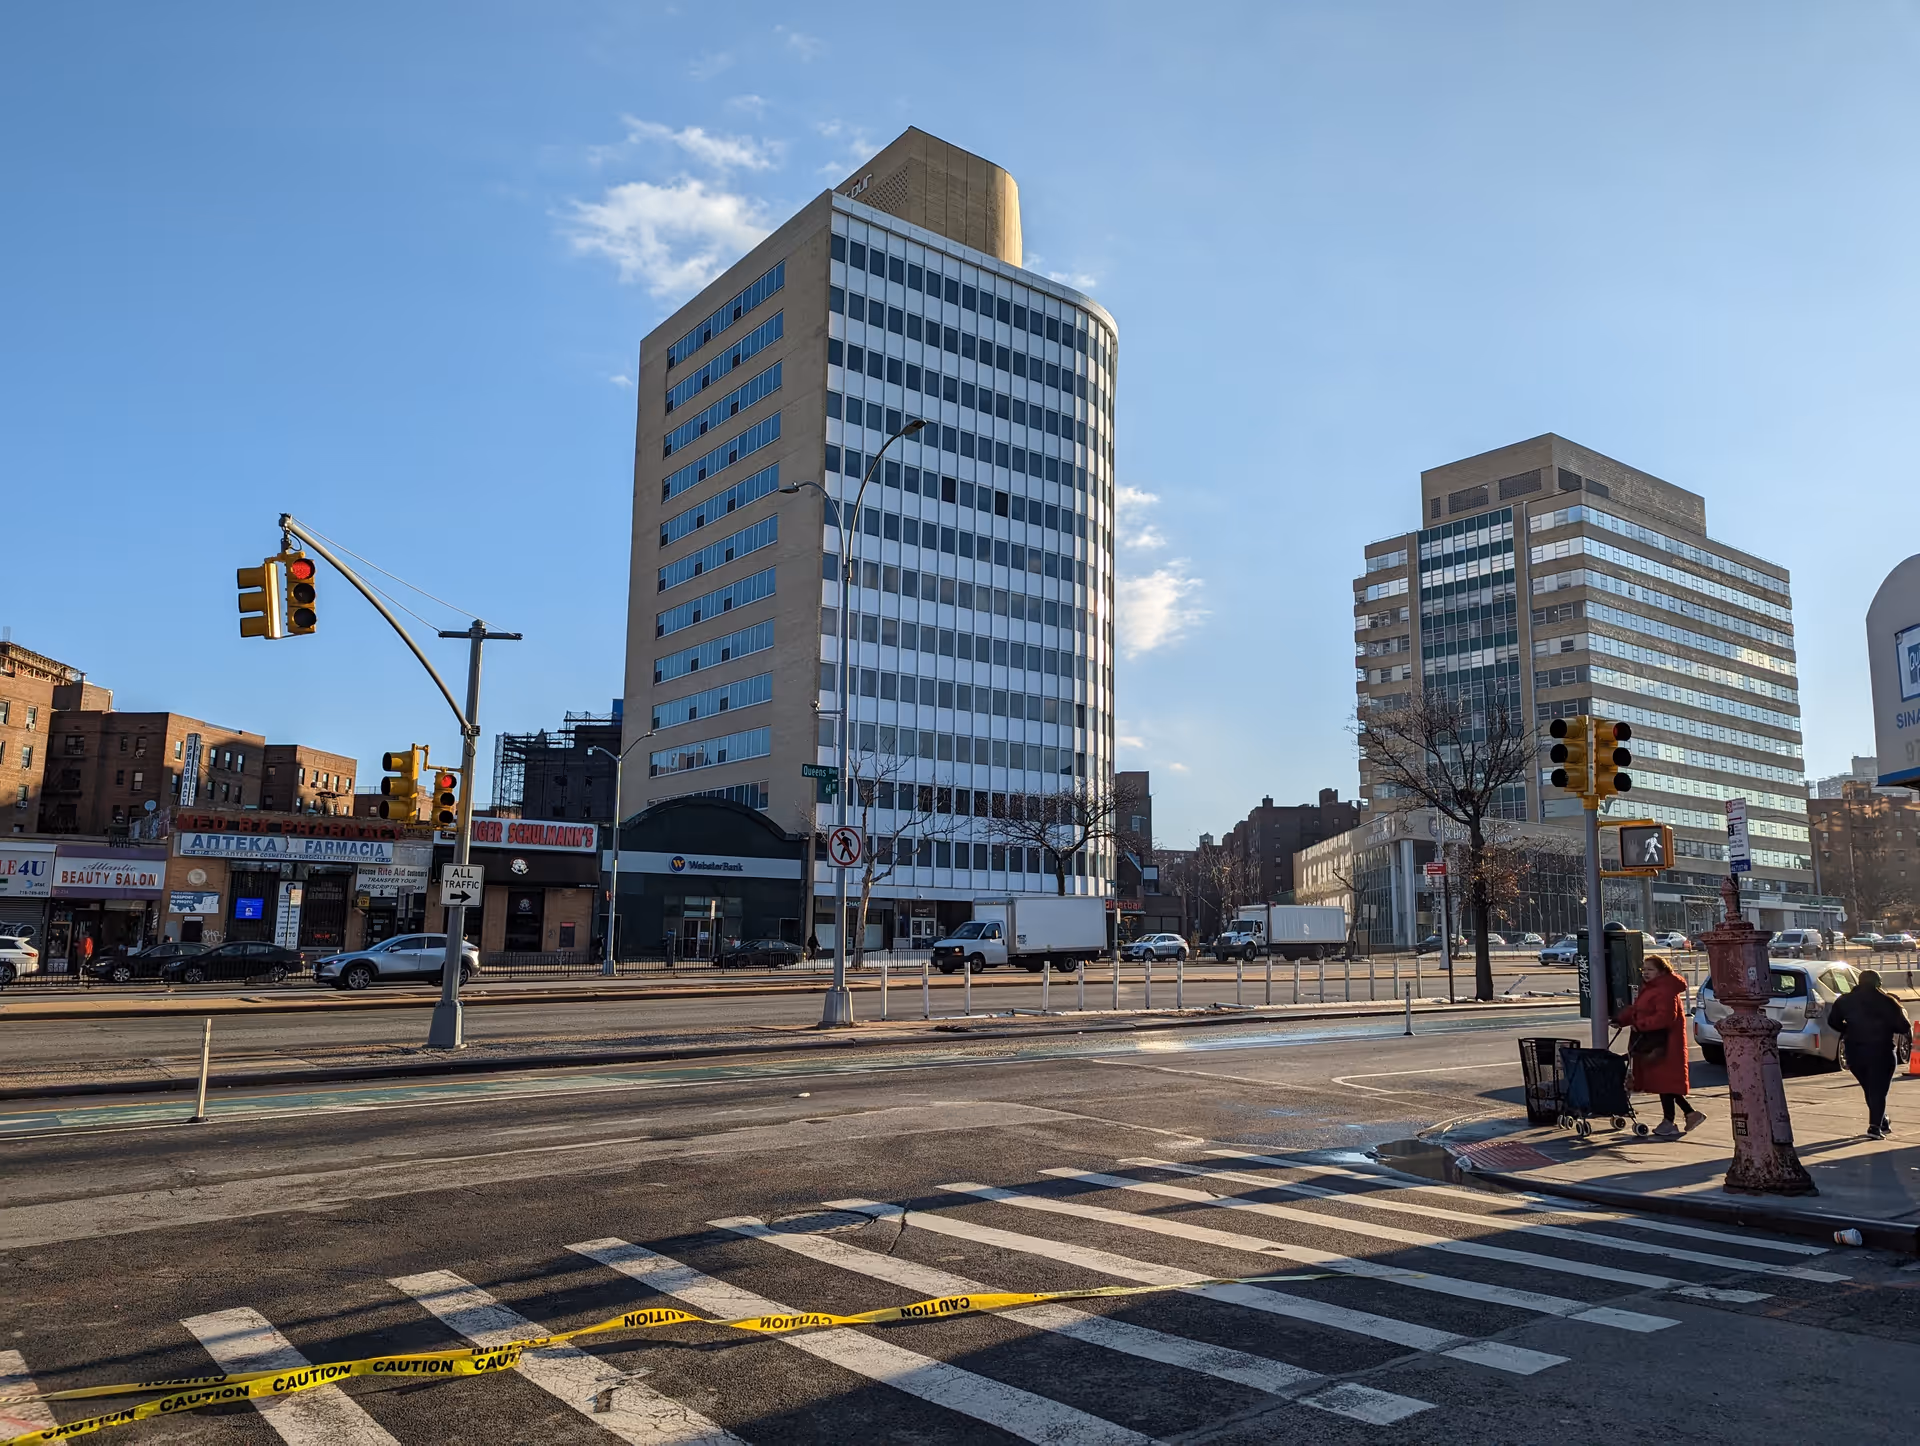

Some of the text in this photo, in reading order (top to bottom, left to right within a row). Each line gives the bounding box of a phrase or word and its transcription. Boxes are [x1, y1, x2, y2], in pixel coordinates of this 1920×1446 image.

[181, 746, 193, 805] PHARMACY
[804, 765, 827, 777] Queens
[177, 814, 401, 840] MED RX PHARMACY
[508, 822, 594, 848] SCHULMANN'S
[190, 834, 277, 852] АПТЕКА
[304, 840, 385, 857] FARMACIA
[82, 862, 137, 872] Atlantic
[377, 867, 393, 877] Rite
[394, 867, 406, 877] Aid
[451, 868, 474, 879] ALL
[61, 870, 157, 886] BEAUTY SALON
[444, 879, 480, 889] TRAFFIC
[624, 1309, 686, 1328] AUTION
[41, 1408, 136, 1440] CAUTION
[159, 1385, 250, 1413] CAUTION
[272, 1363, 353, 1392] CAUTION
[373, 1359, 454, 1373] CAUTION
